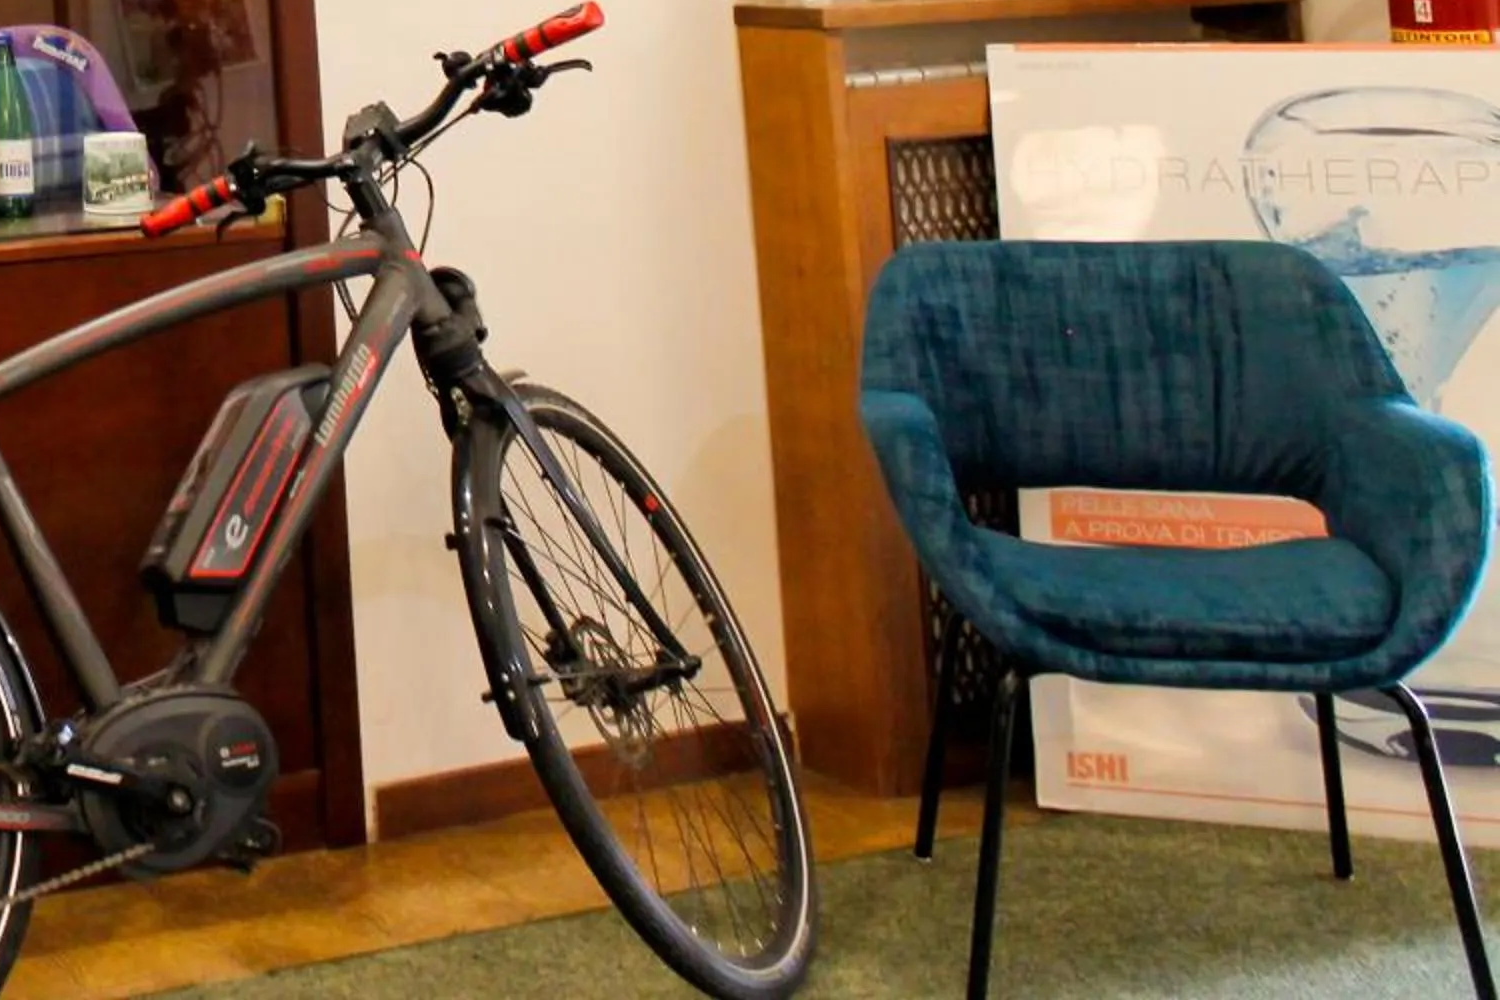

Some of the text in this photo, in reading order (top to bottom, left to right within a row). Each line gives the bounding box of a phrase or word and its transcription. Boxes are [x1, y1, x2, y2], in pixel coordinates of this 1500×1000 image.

[1027, 156, 1500, 196] HYDRATHERAP
[1061, 494, 1216, 520] PELLE SANA
[1064, 518, 1084, 538] A
[1088, 519, 1175, 541] PROVA
[1180, 521, 1206, 543] DI
